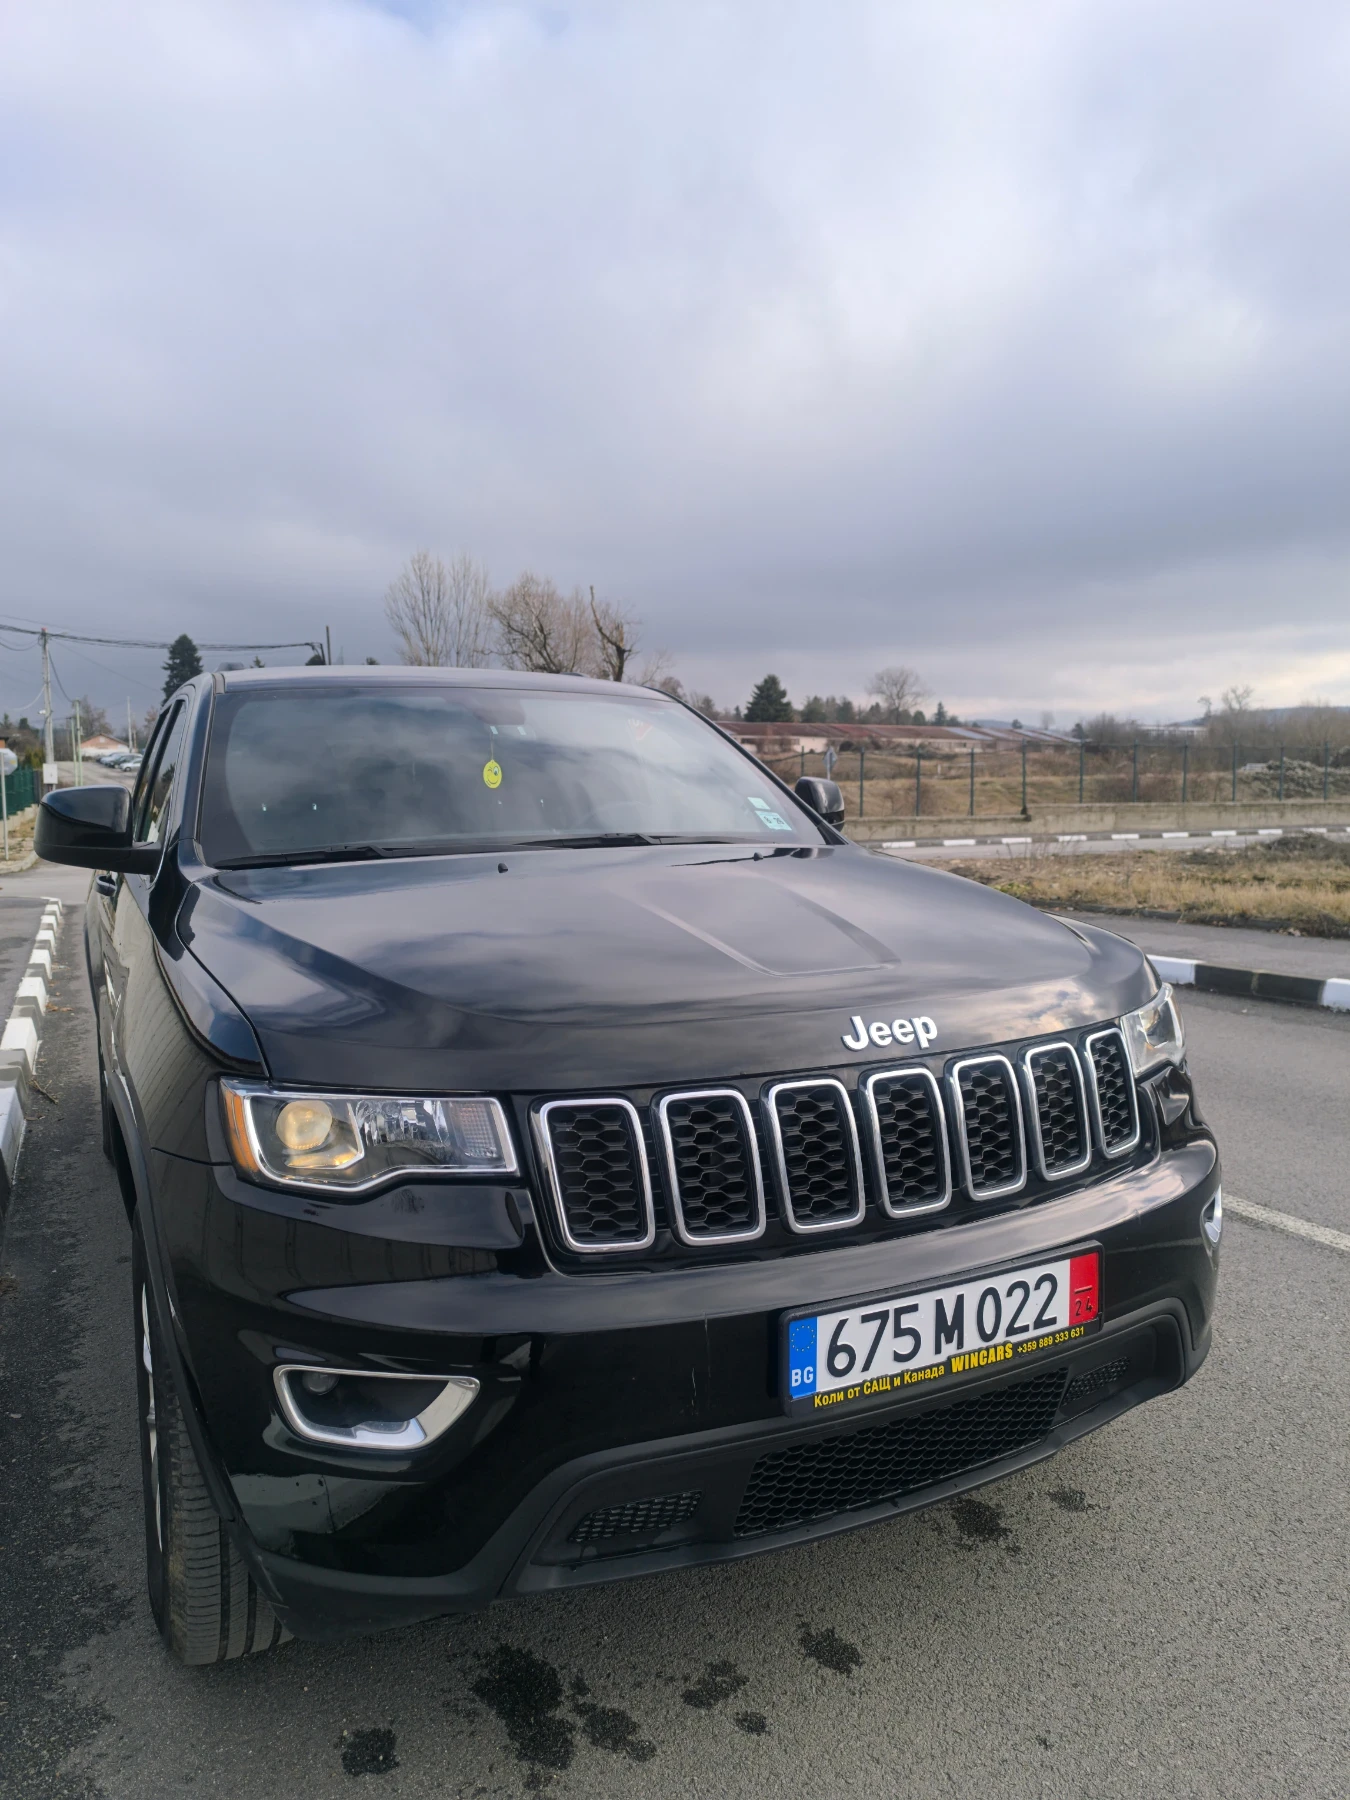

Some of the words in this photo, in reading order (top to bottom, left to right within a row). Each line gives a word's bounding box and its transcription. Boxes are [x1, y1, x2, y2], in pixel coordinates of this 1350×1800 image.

[841, 1015, 938, 1051] Jeep
[1075, 1296, 1093, 1317] 24
[826, 1303, 922, 1378] 675
[934, 1293, 965, 1356] M
[976, 1272, 1059, 1343] 022
[791, 1365, 814, 1387] BG
[814, 1390, 844, 1408] Коли
[847, 1386, 861, 1399] от
[863, 1376, 891, 1395] САЩ
[893, 1376, 901, 1387] и
[904, 1364, 945, 1385] Канада
[951, 1342, 1013, 1373] WINCARS
[1016, 1340, 1037, 1354] +359
[1038, 1336, 1054, 1348] 889
[1055, 1330, 1069, 1343] 333
[1070, 1326, 1085, 1338] 631
